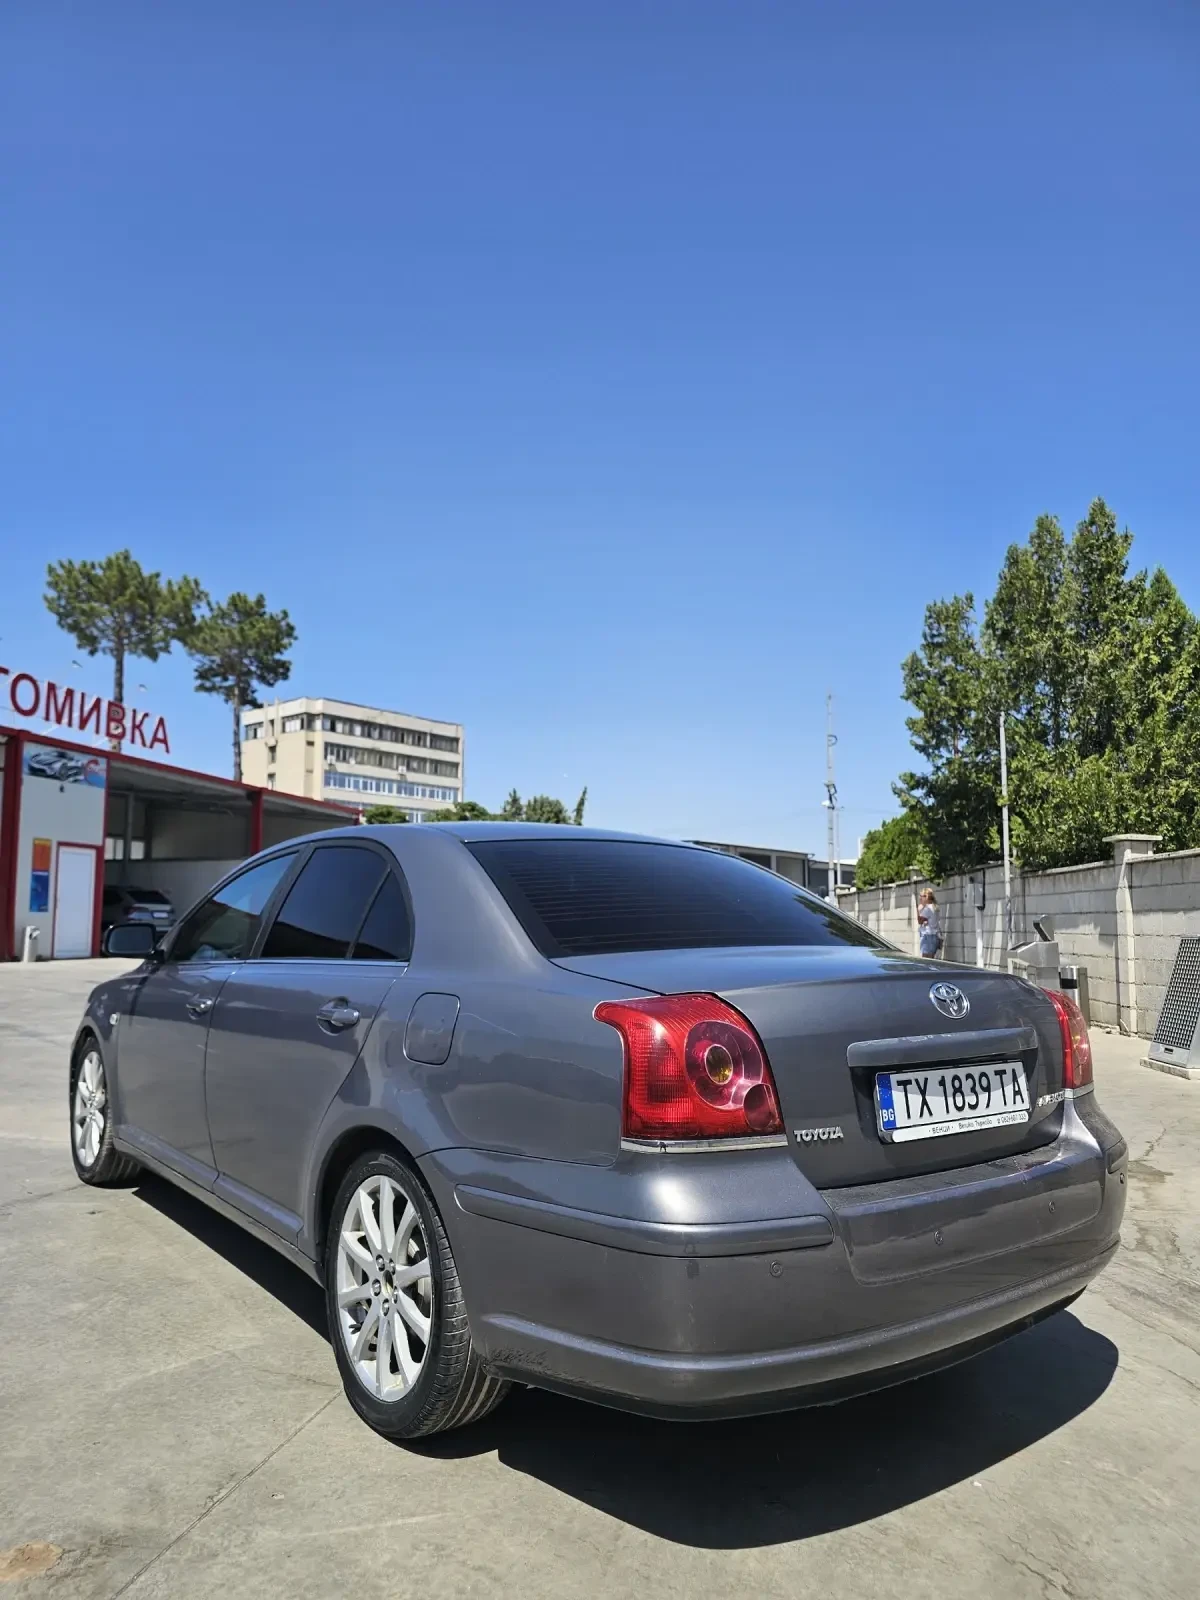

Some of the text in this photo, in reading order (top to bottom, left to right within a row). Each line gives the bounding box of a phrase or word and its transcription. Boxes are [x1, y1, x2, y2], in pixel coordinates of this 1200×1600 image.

[0, 666, 170, 754] ОМИВКА
[896, 1077, 933, 1119] TX
[938, 1072, 991, 1114] 1839
[994, 1068, 1025, 1107] TA
[882, 1109, 895, 1122] BG
[793, 1126, 844, 1142] TOYOTA
